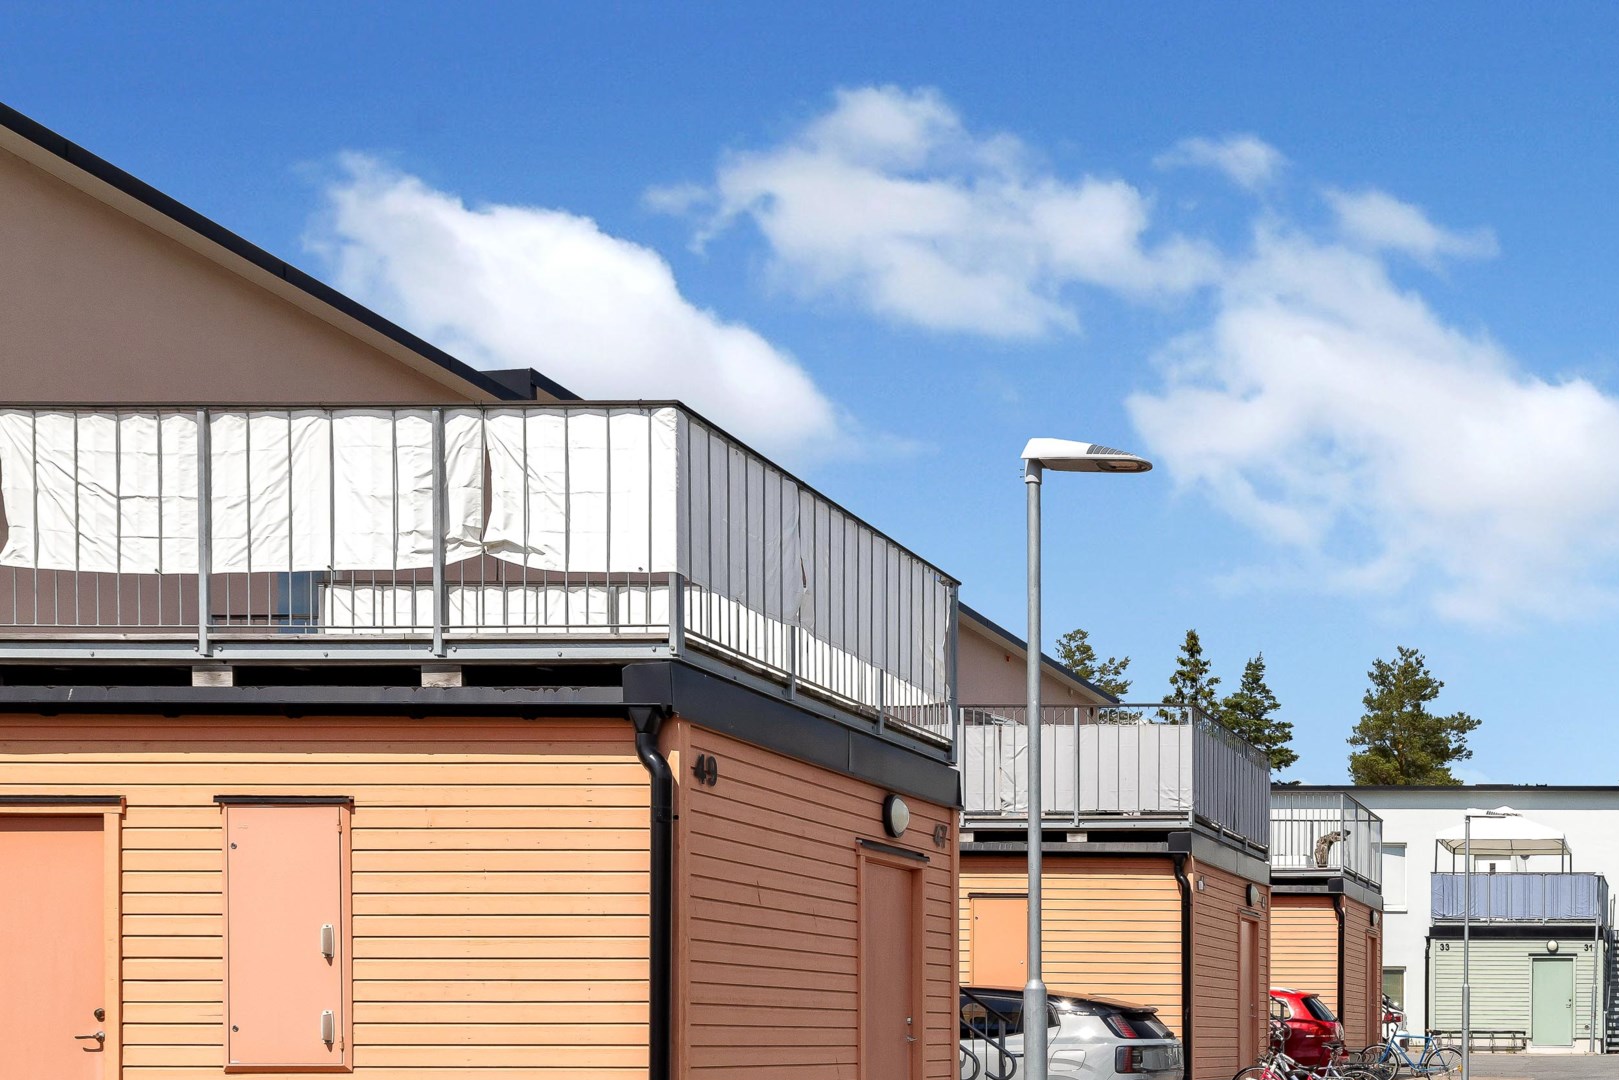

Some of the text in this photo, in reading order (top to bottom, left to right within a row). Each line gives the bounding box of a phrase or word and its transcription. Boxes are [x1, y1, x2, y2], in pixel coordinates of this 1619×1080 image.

[693, 753, 718, 787] 49
[933, 823, 948, 849] 47
[1439, 943, 1450, 952] 33
[1583, 943, 1593, 952] 31
